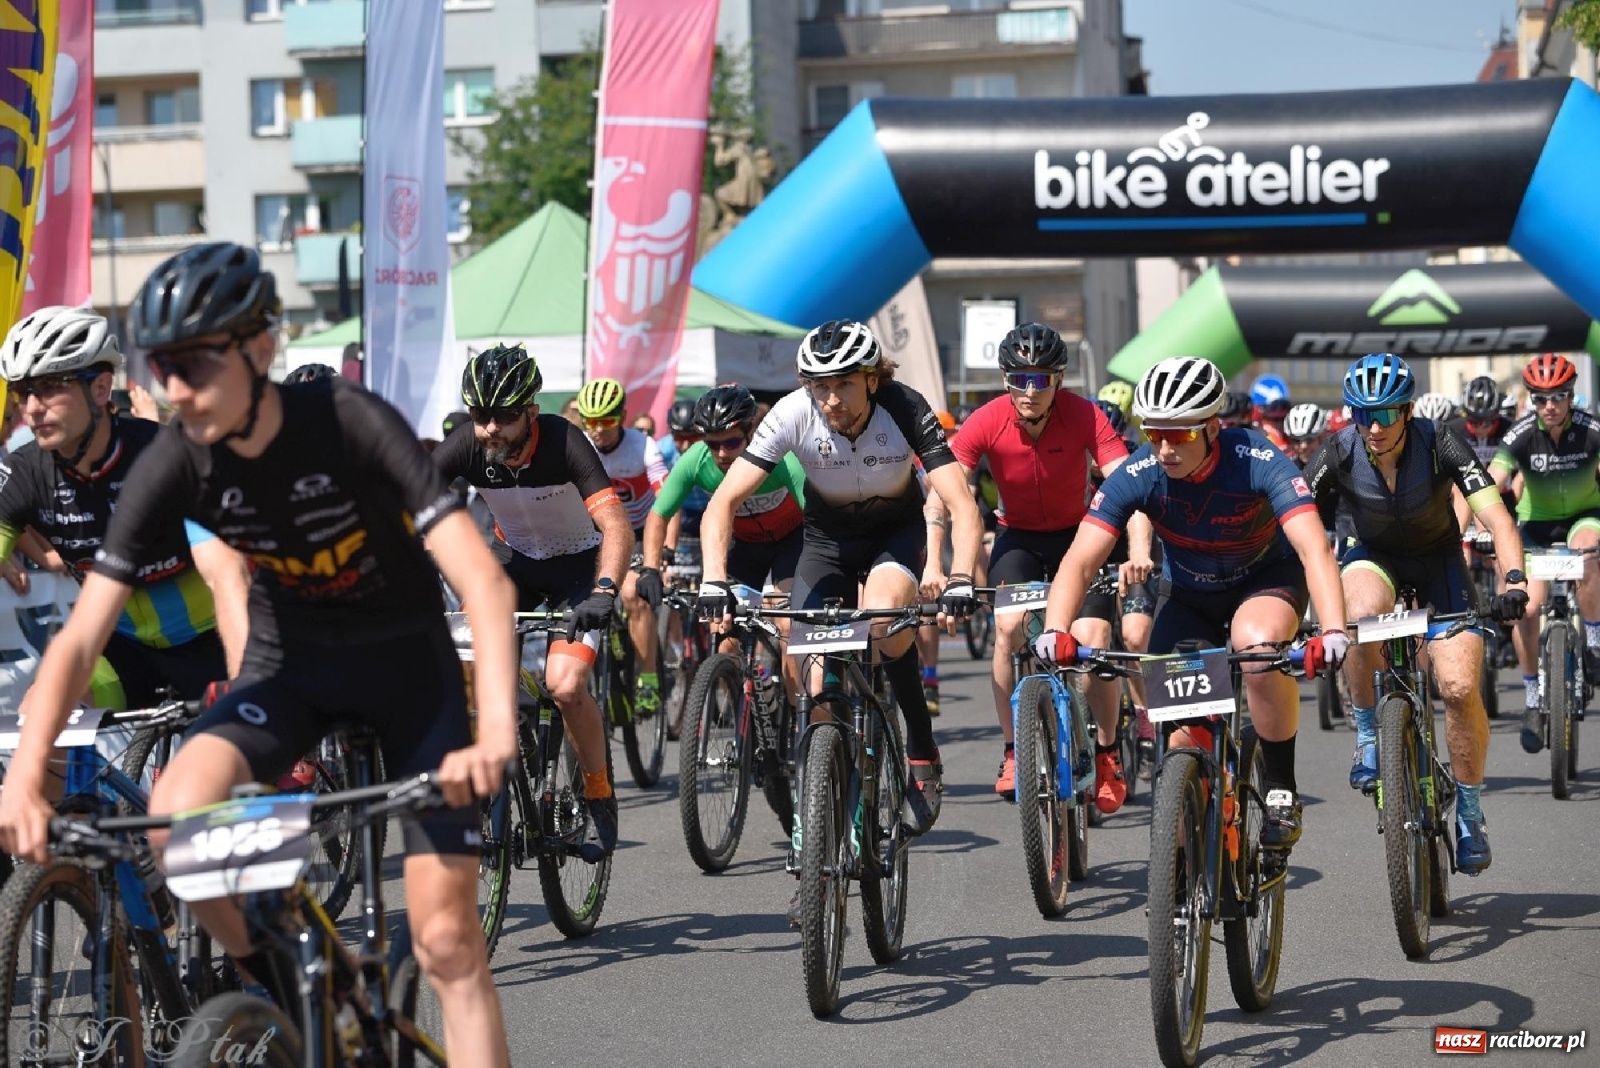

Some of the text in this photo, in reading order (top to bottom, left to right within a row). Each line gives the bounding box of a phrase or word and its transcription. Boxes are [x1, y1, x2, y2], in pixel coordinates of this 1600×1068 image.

[1035, 145, 1391, 209] bike atelier
[1287, 325, 1549, 354] MERIDA
[1010, 590, 1046, 602] 1321
[805, 628, 855, 641] 1069
[1164, 673, 1212, 699] 1173
